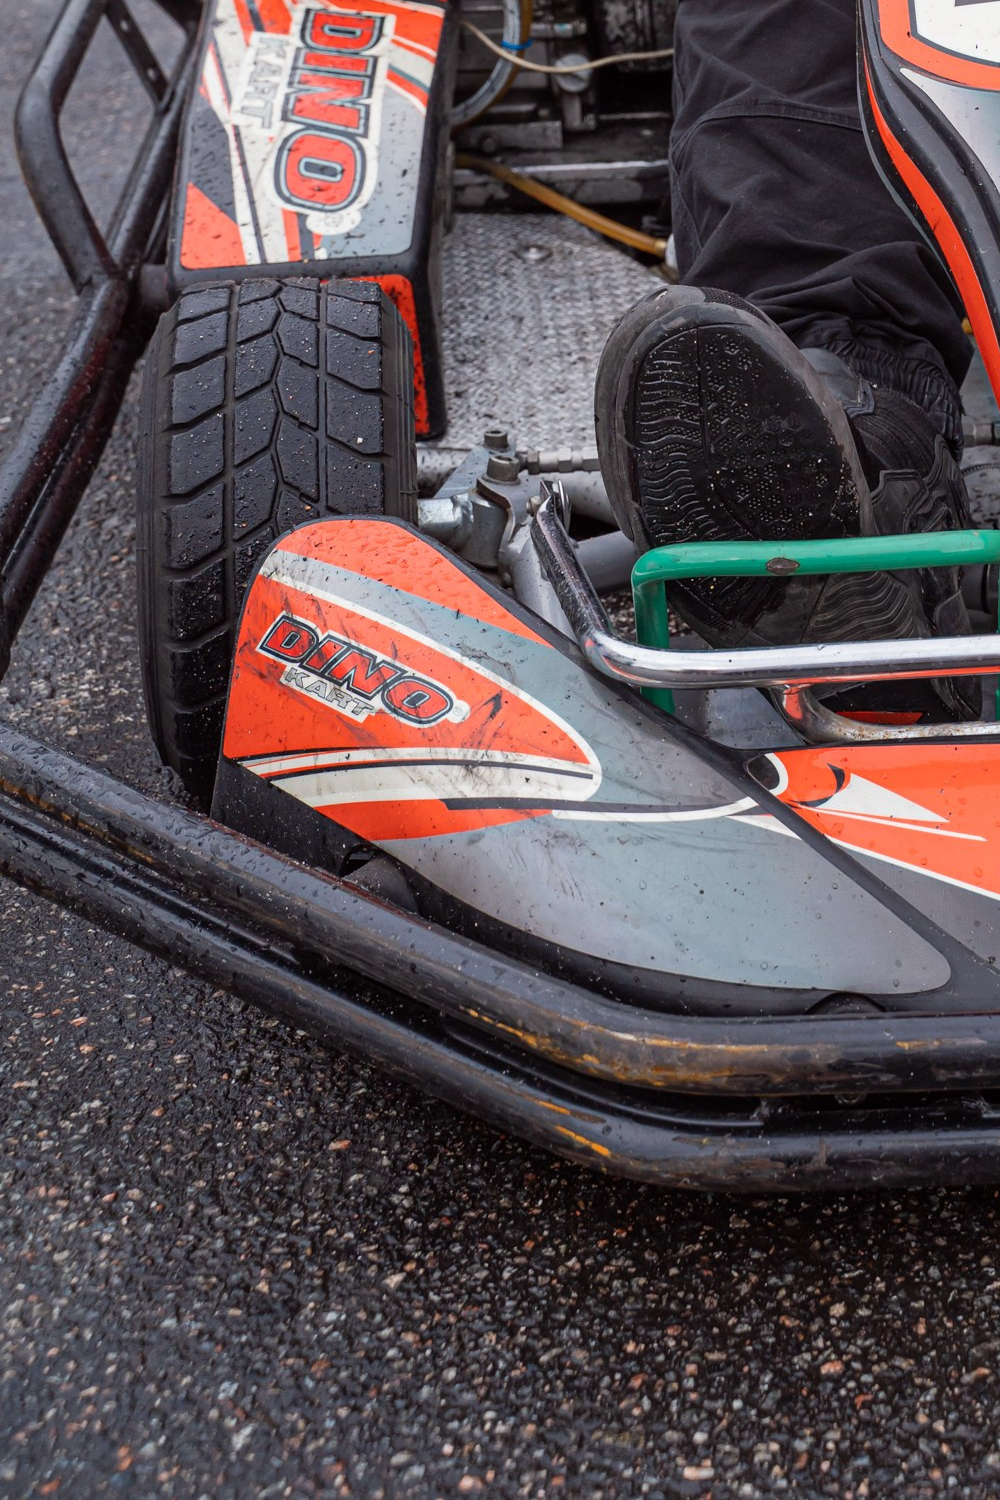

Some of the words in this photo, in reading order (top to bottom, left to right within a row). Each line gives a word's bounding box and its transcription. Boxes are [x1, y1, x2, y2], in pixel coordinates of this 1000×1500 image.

[240, 36, 290, 130] KART
[273, 7, 387, 213] DINO
[259, 614, 454, 725] DINO
[284, 667, 375, 716] KART
